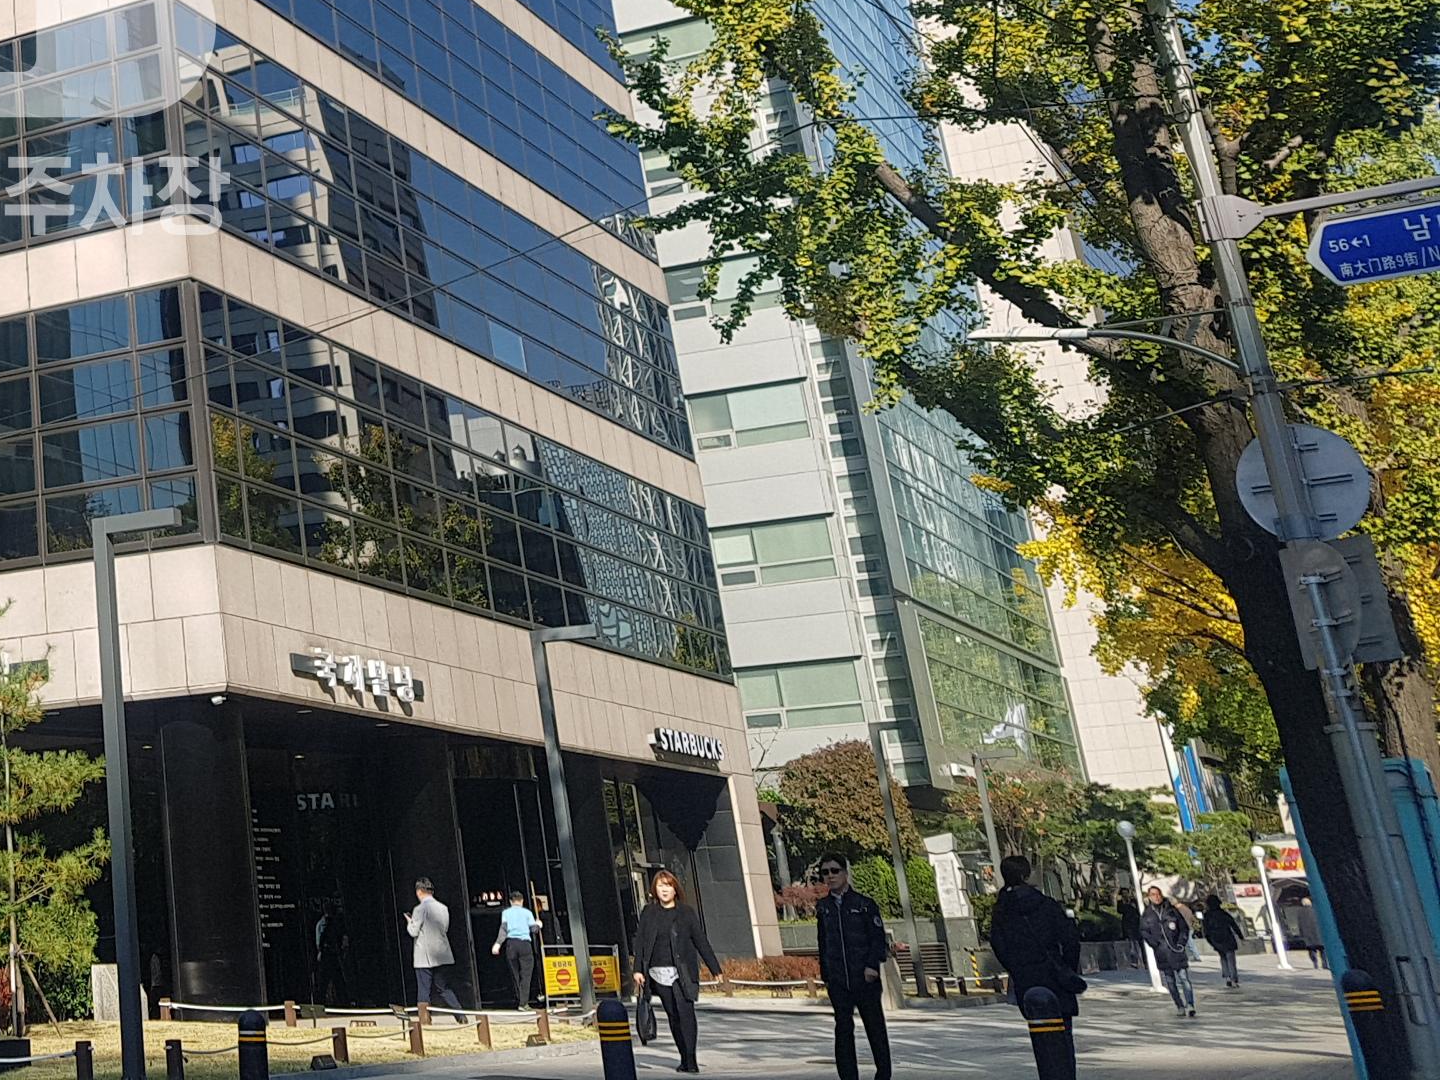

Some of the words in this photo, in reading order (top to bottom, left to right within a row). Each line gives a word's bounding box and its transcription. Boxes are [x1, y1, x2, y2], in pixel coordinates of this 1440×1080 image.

[1403, 214, 1440, 241] 남
[310, 647, 415, 703] 국제빌딩
[659, 727, 725, 761] STARBUCKS
